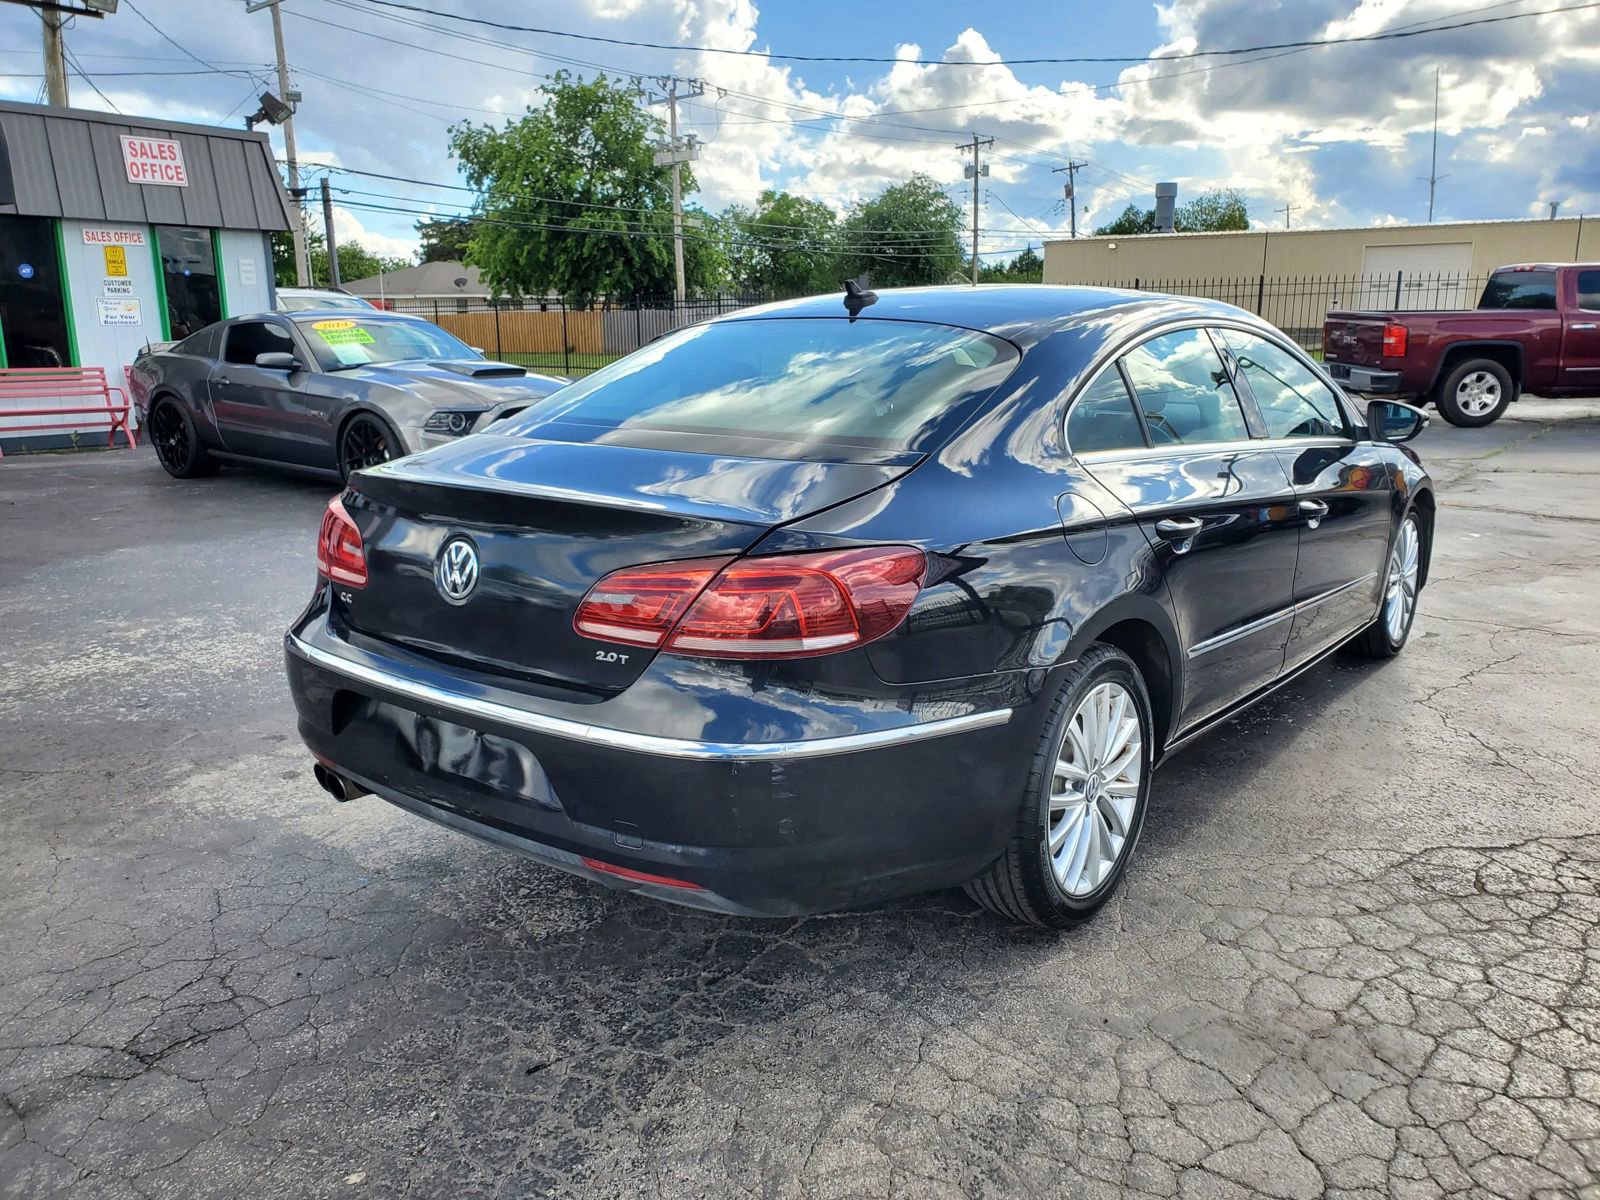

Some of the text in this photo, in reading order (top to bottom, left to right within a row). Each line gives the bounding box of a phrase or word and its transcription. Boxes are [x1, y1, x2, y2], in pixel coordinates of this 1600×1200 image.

[128, 141, 177, 161] SALES
[129, 163, 185, 181] OFFICE
[85, 231, 143, 243] SALES OFFICE
[340, 592, 353, 604] CC
